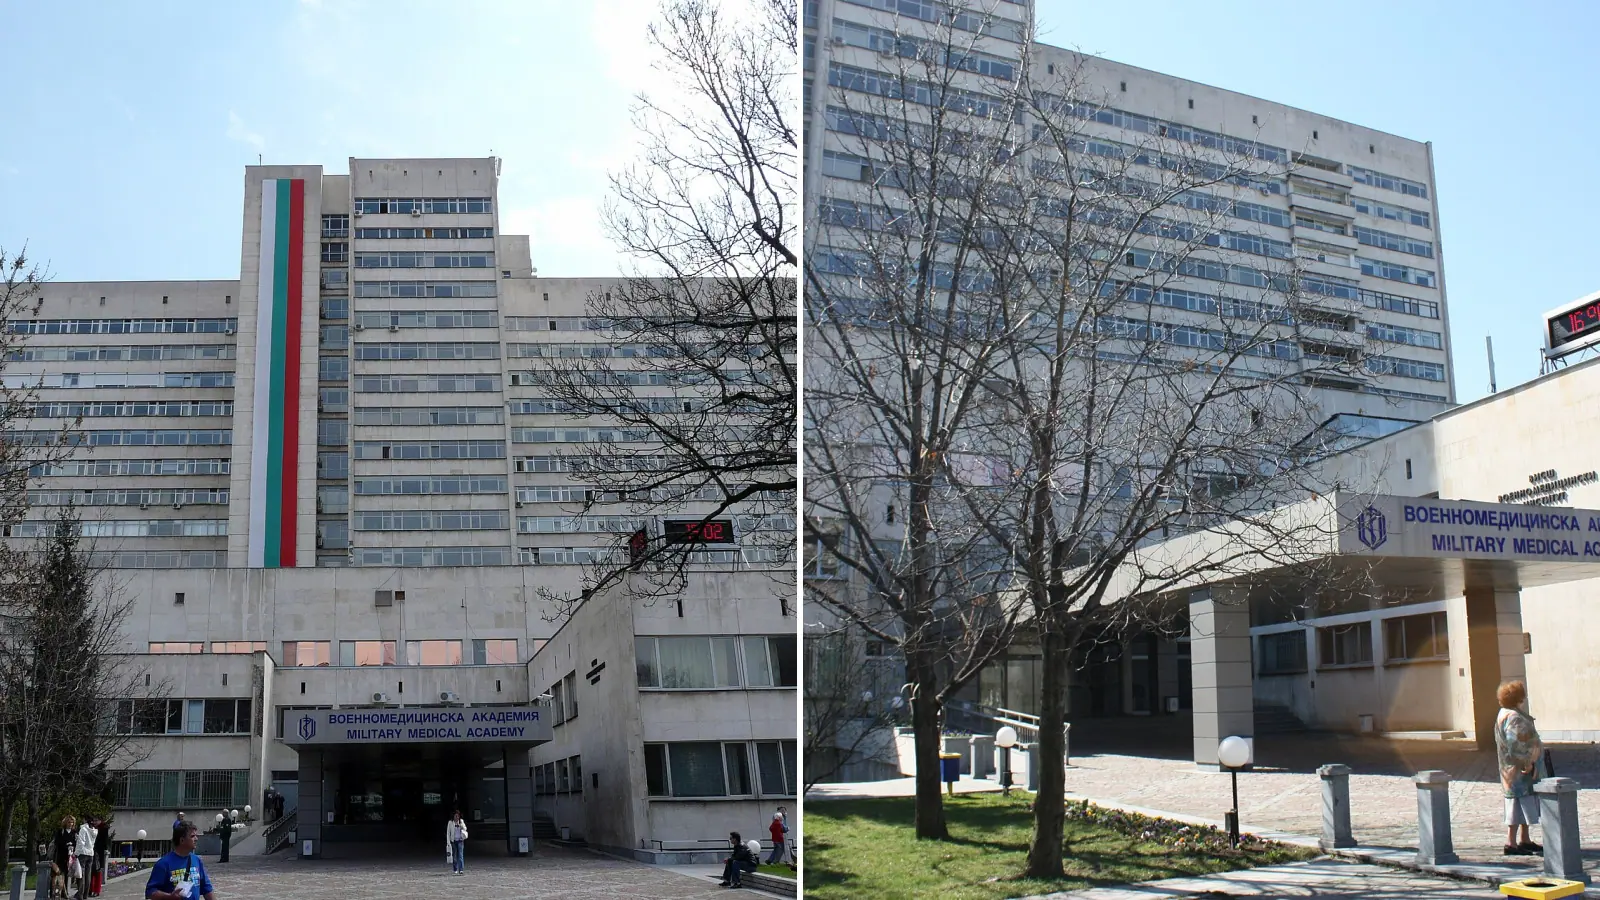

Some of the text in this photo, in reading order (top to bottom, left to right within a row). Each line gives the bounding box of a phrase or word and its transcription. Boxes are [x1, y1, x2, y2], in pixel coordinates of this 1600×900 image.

[1404, 505, 1580, 532] ВОЕННОМЕДИЦИНСКА
[1432, 534, 1506, 553] MILITARY
[1513, 538, 1579, 556] MEDICAL
[328, 711, 539, 725] ВОЕННОМЕДИЦИНСКА АКАДЕМИЯ
[347, 727, 525, 739] MILITARY MEDICAL ACADEMY
